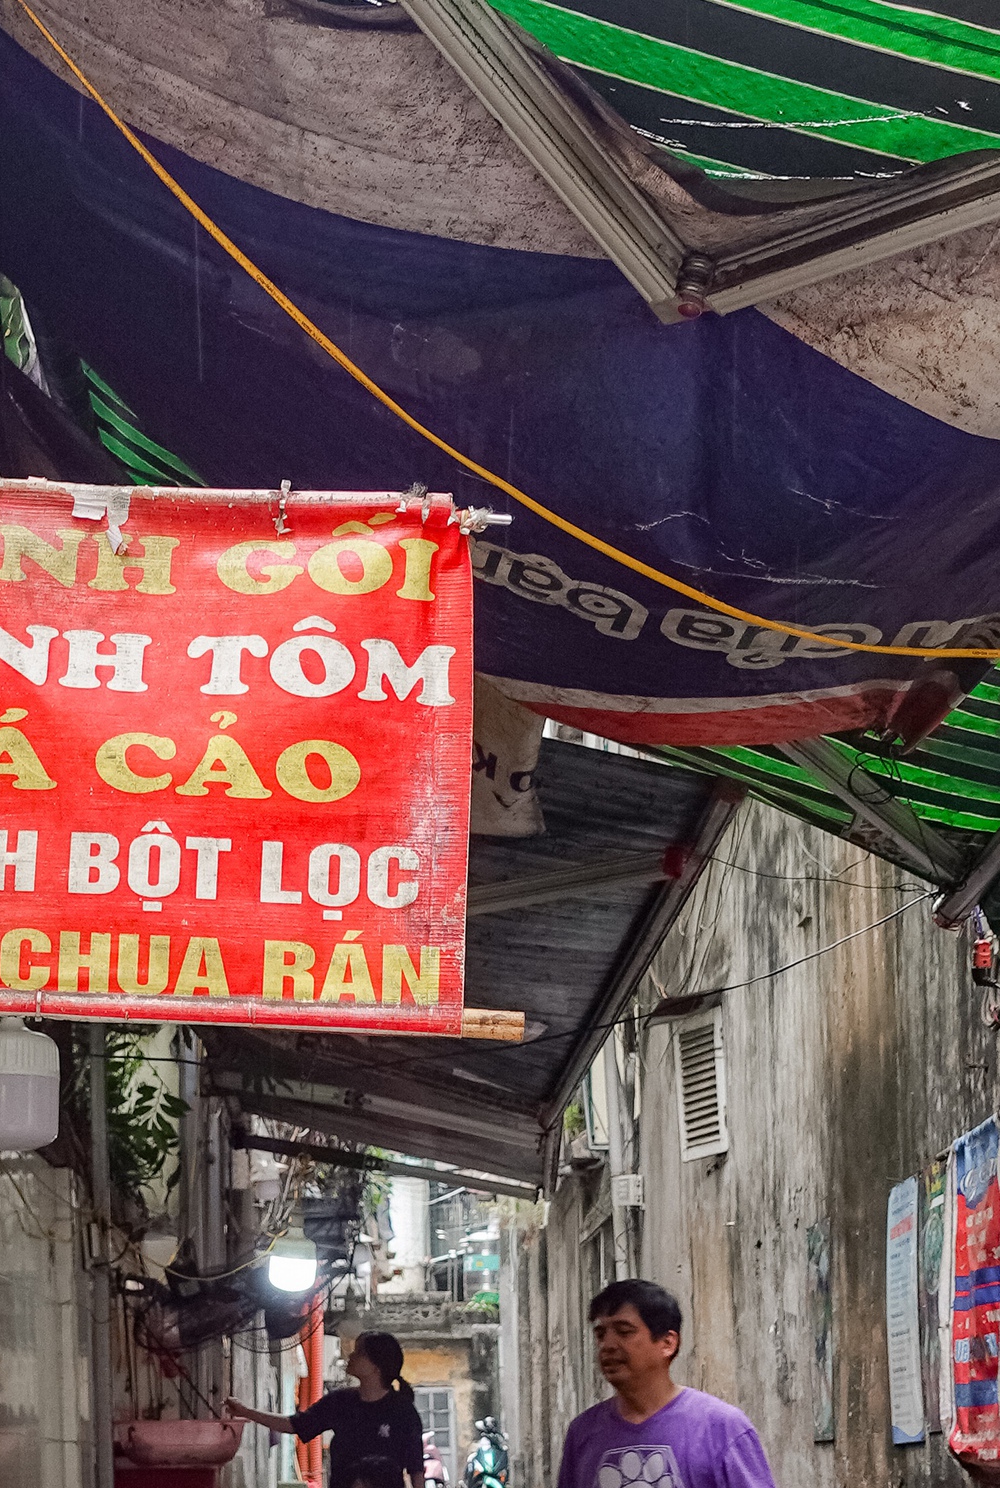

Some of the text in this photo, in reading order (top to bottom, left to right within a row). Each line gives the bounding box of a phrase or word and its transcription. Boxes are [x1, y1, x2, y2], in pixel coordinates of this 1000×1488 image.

[216, 512, 440, 602] GỐI
[186, 615, 457, 707] TÔM
[95, 709, 362, 803] CẢO
[68, 820, 232, 912] BỘT
[260, 840, 420, 921] LỌC
[0, 926, 232, 998] CHUA
[261, 930, 441, 1007] RÁN
